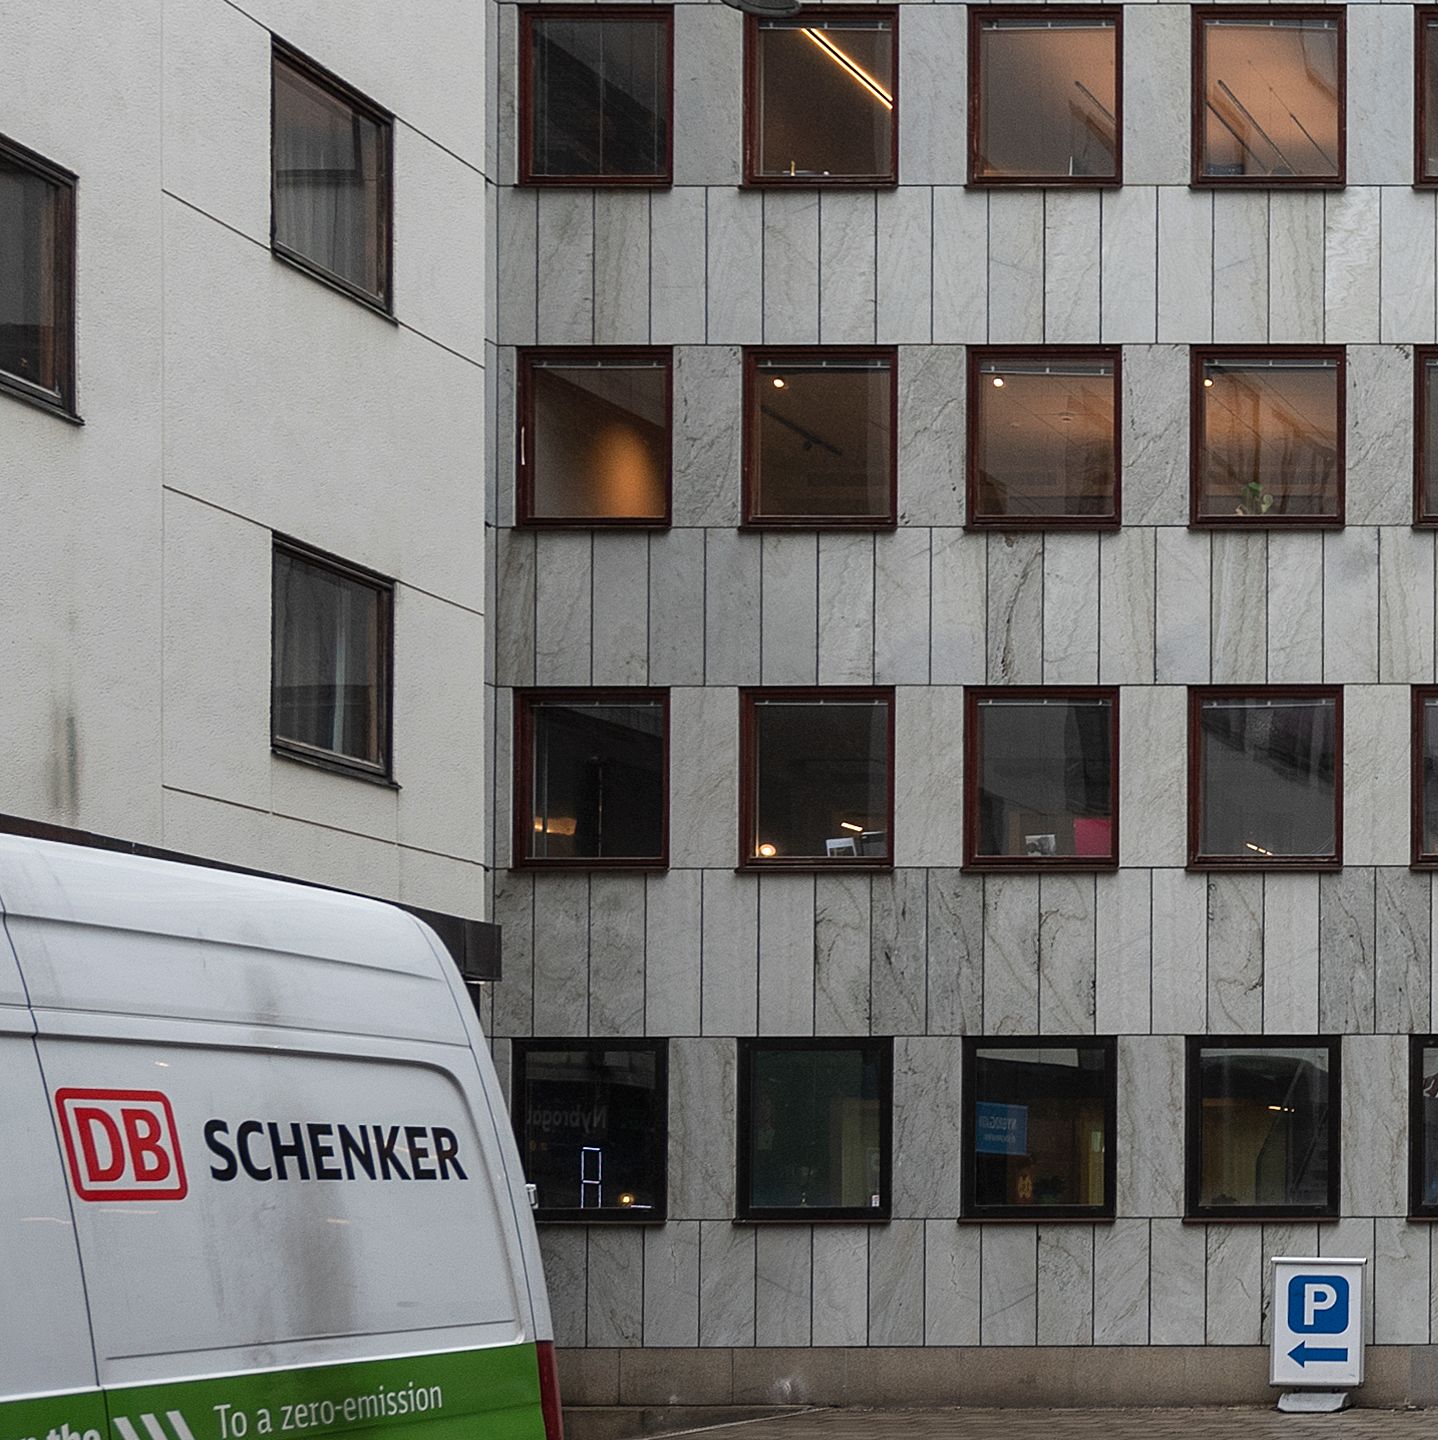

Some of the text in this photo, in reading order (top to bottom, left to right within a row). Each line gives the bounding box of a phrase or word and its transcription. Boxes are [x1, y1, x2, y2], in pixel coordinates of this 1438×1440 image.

[74, 1107, 468, 1182] DB SCHENKER
[1304, 1283, 1337, 1325] P
[213, 1381, 443, 1440] To a zero-emission
